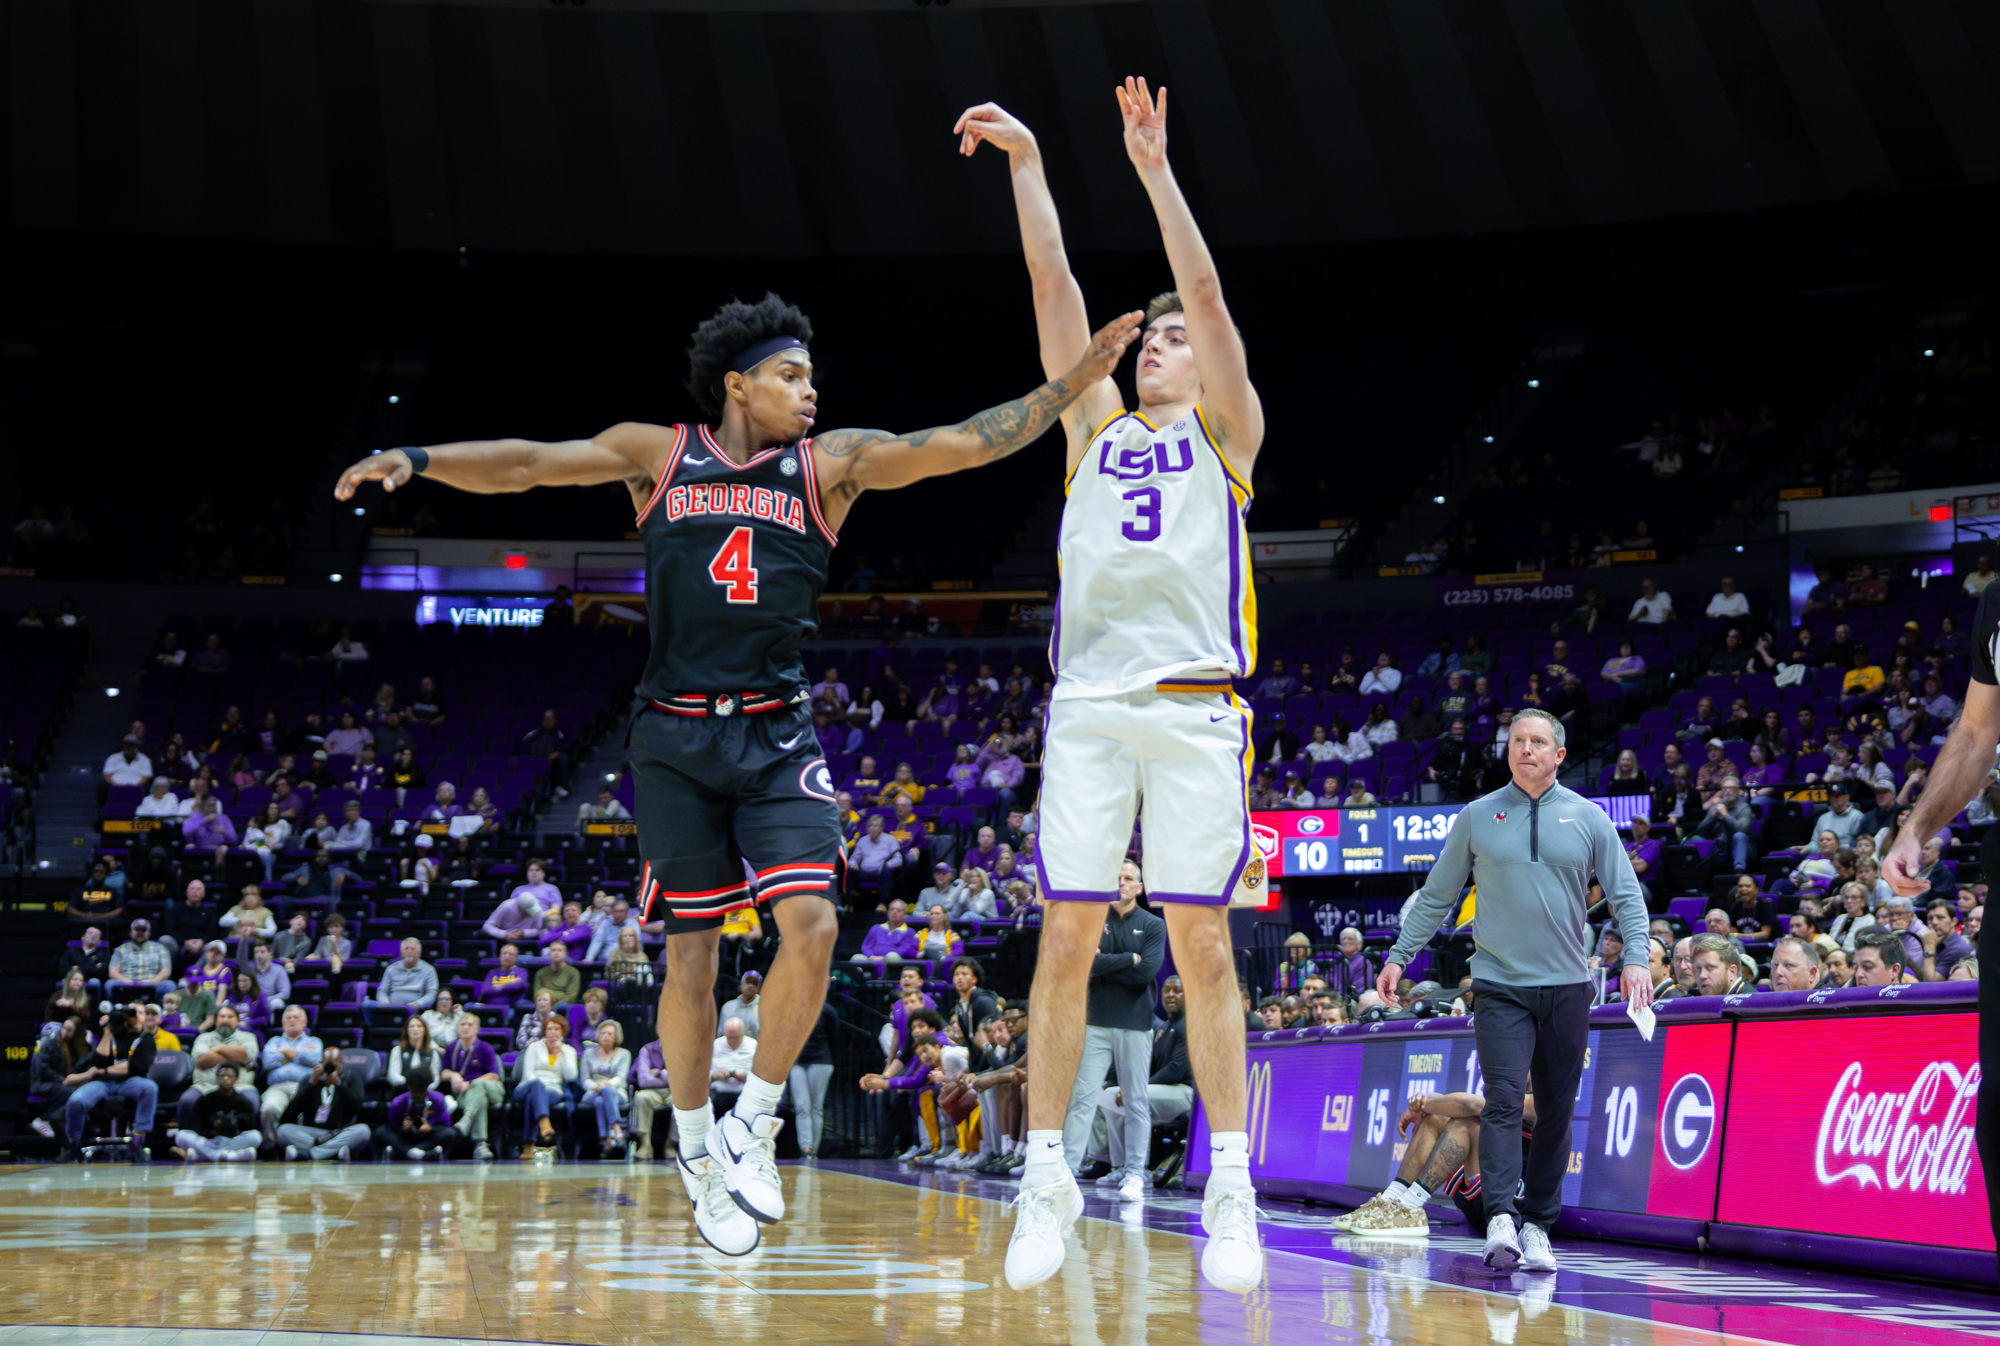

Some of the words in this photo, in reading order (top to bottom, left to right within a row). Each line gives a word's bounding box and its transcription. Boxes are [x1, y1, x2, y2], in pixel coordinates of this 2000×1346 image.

[1098, 436, 1194, 480] LSU
[666, 483, 806, 535] GEORGIA
[1121, 485, 1161, 541] 3
[708, 525, 758, 604] 4
[1444, 589, 1489, 606] (225)
[1494, 585, 1575, 602] 578-4085
[450, 607, 544, 627] VENTURE
[1349, 810, 1377, 819] FOULS
[1358, 823, 1368, 843] 1
[1294, 841, 1328, 870] 10
[1342, 847, 1384, 857] TIMEOUTS
[83, 890, 112, 901] LSU
[5, 1046, 28, 1060] 109
[1408, 1054, 1443, 1073] TIMEOUTS
[1322, 1095, 1353, 1131] LSU
[1366, 1088, 1390, 1145] 15
[1605, 1085, 1638, 1158] 10
[1661, 1073, 1715, 1171] G
[1816, 1061, 1982, 1195] Coca-Cola
